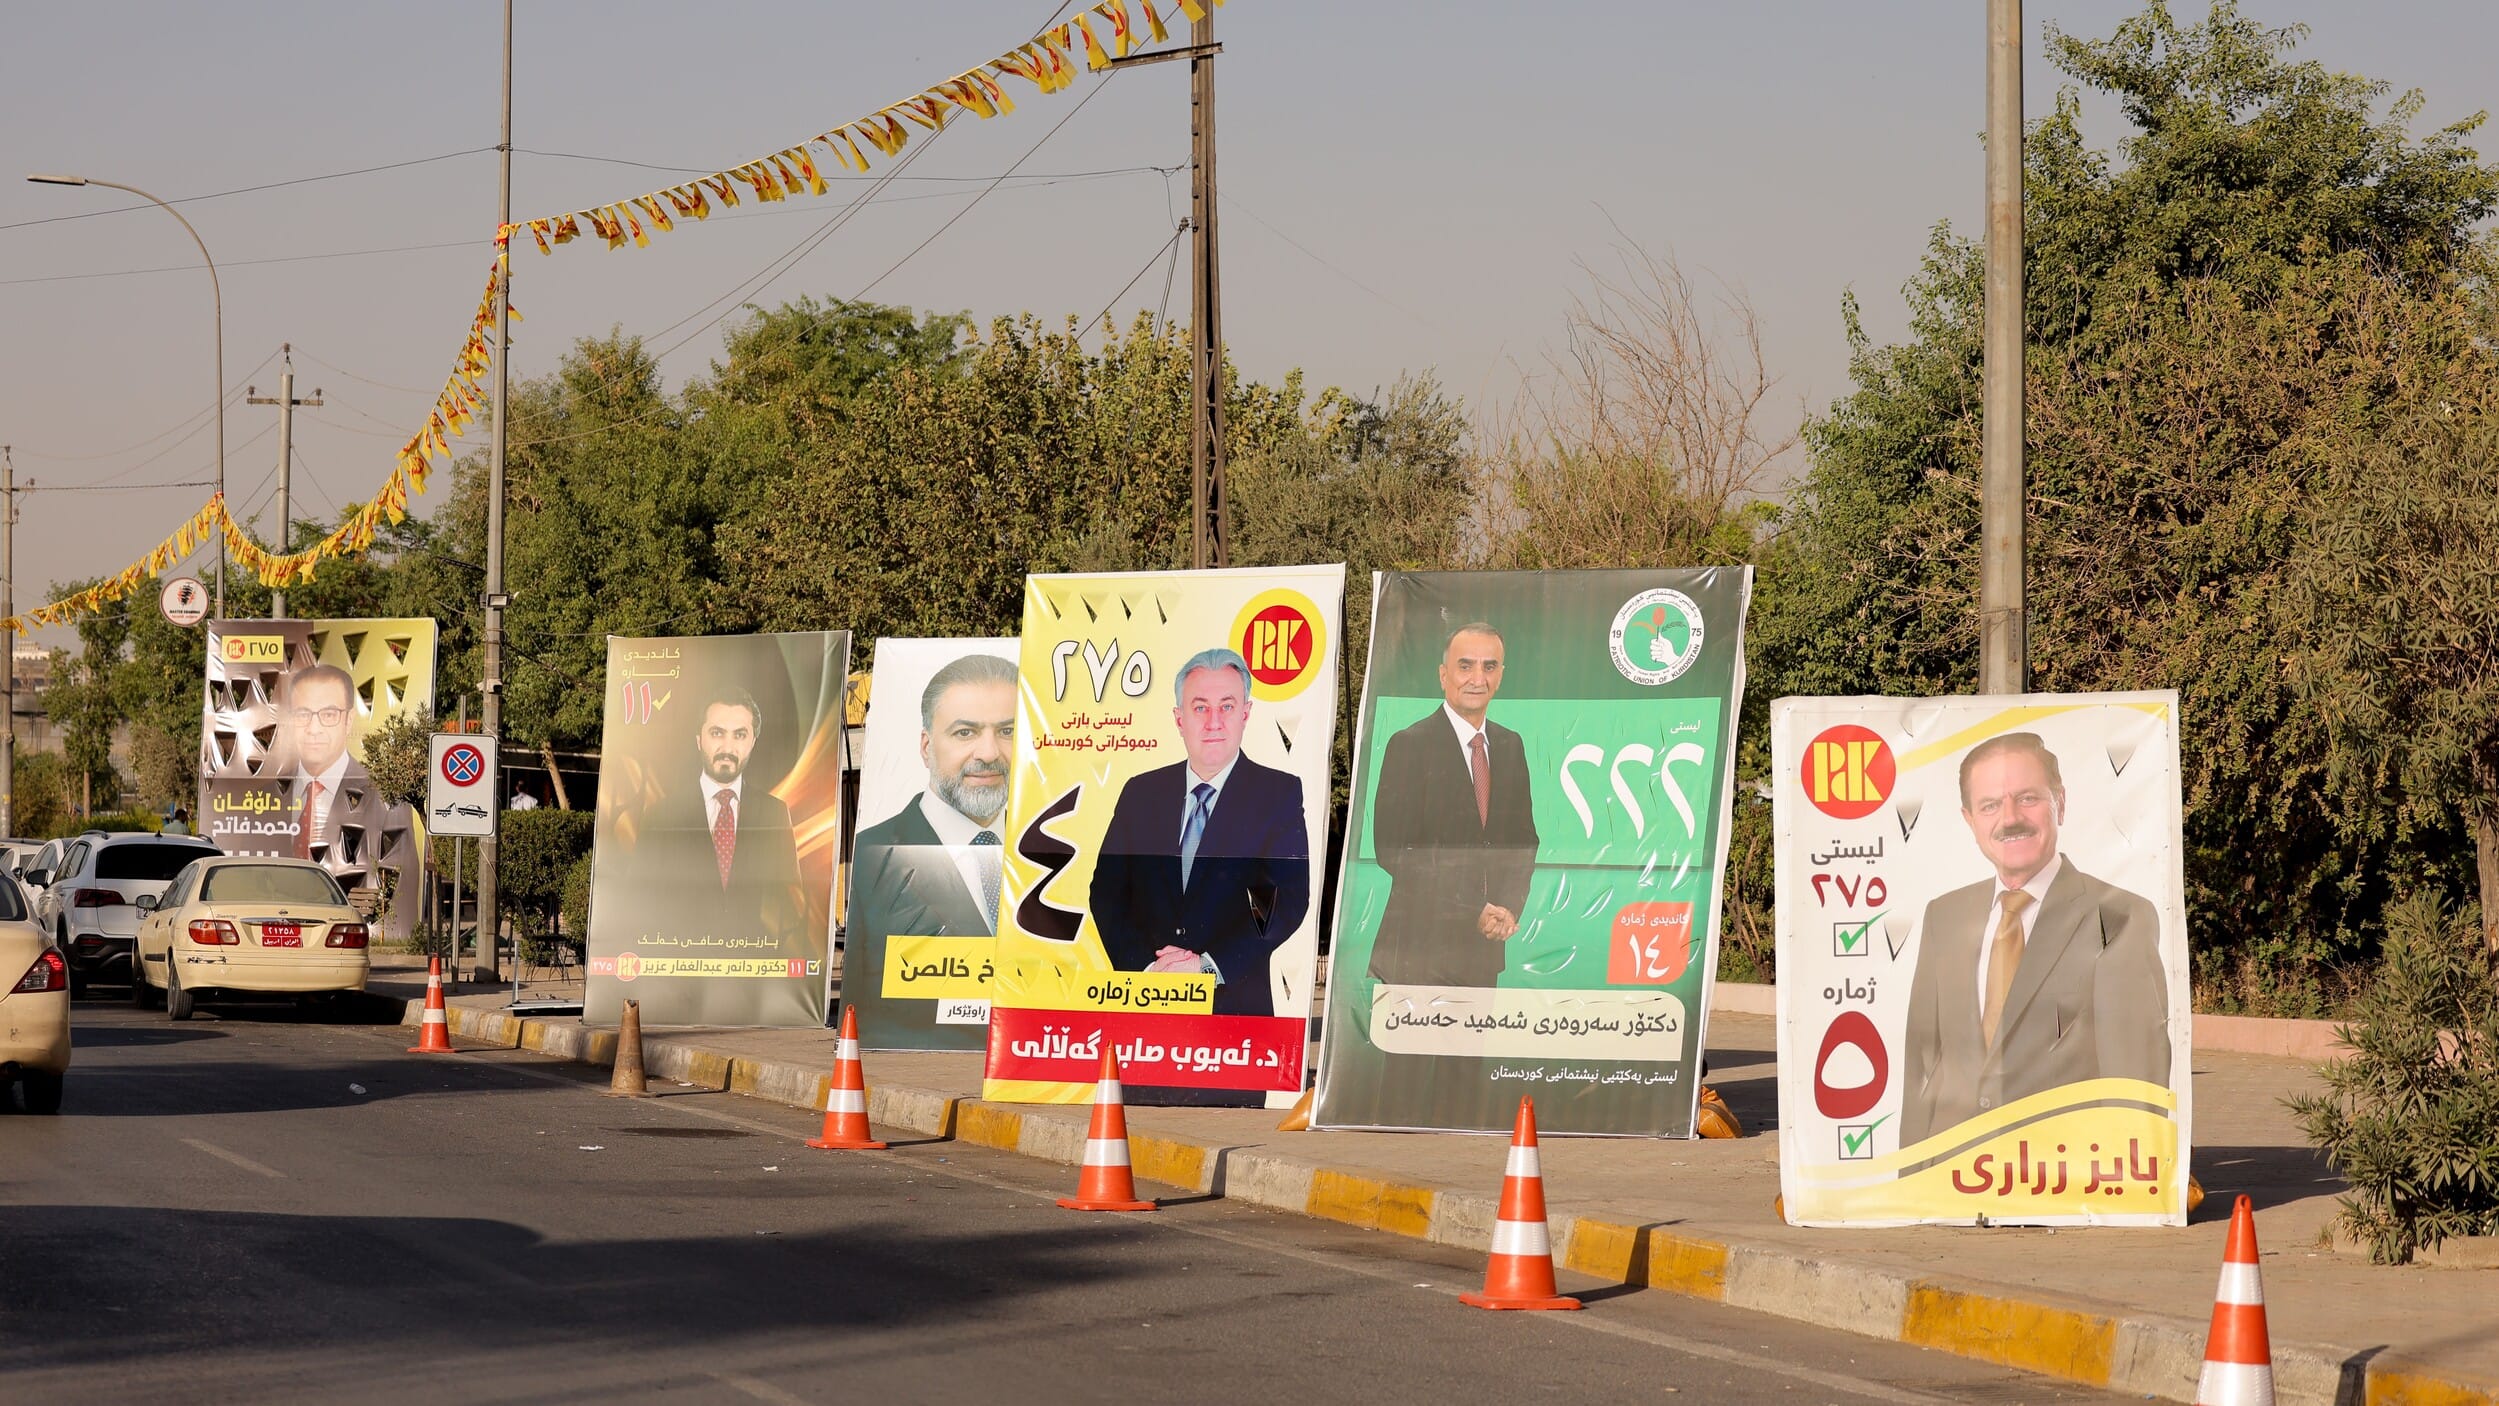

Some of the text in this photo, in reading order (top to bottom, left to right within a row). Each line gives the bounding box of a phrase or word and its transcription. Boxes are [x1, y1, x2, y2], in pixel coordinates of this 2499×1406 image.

[1612, 630, 1622, 639] 19
[1691, 628, 1702, 637] 75
[249, 642, 279, 656] ٢٧٥
[1051, 637, 1153, 703] ٢٧٥
[1611, 646, 1631, 677] PATRIOTIC
[1633, 675, 1655, 685] UNION
[1658, 675, 1668, 684] OF
[1671, 644, 1700, 678] KURDISTAN
[623, 681, 652, 725] ١١
[1093, 712, 1132, 729] لیستی
[1670, 720, 1702, 734] لیستی
[1032, 733, 1158, 752] دیموکراتی کوردستان
[1559, 742, 1705, 840] ٢٢٢
[1016, 782, 1086, 944] ٤
[1810, 836, 1885, 866] لیستی
[1811, 874, 1888, 908] ٢٧٥
[900, 957, 970, 982] خالص
[1629, 934, 1670, 978] ١٤
[1087, 977, 1207, 1007] کاندیدی ژمارە
[1822, 976, 1878, 1004] ژمارە
[1385, 1010, 1678, 1037] دکتۆر سەروەری شەهید حەسەن
[1170, 1039, 1252, 1073] ئەیوب
[1256, 1050, 1279, 1068] د.
[1813, 1010, 1889, 1119] ٥
[1490, 1065, 1544, 1082] کوردستان
[1545, 1067, 1599, 1083] نیشتمانیی
[1644, 1069, 1678, 1085] لیستی
[1951, 1138, 2159, 1196] بایز زراری
